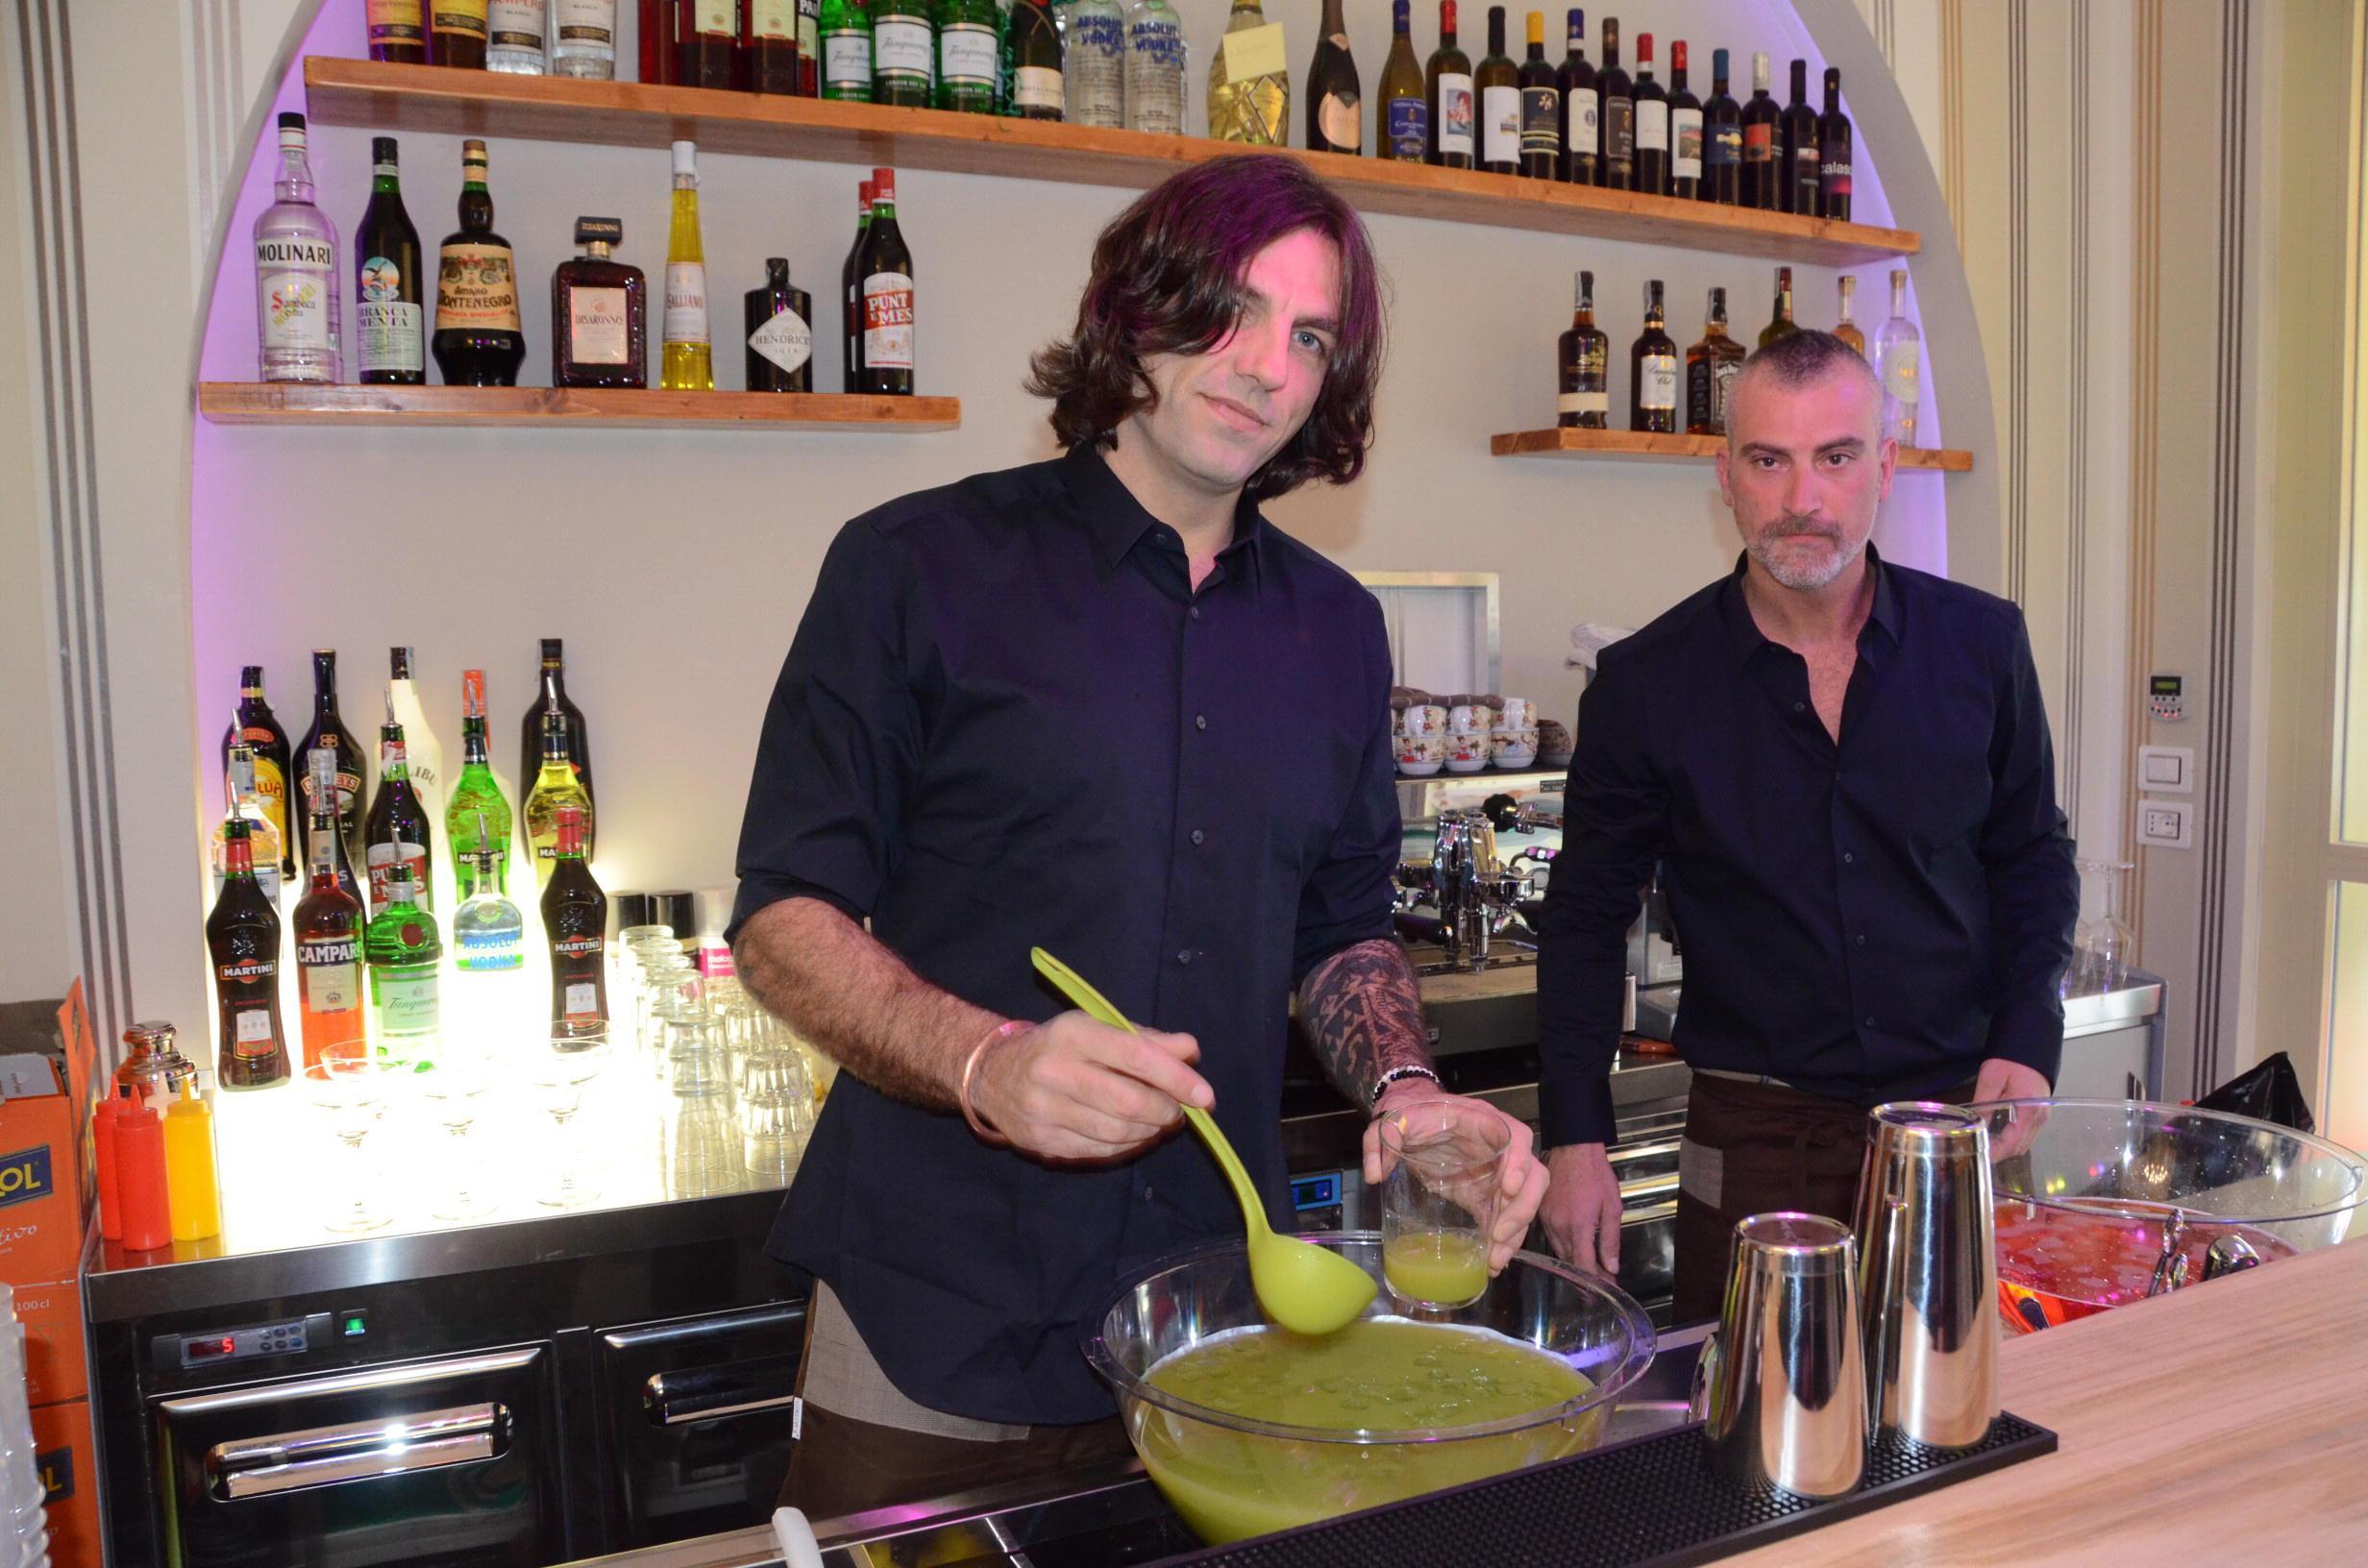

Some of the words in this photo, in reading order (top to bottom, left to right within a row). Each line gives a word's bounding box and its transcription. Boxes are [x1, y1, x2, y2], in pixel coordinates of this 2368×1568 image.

[258, 243, 331, 265] MOLINARI
[868, 292, 908, 311] PUNT
[358, 306, 407, 317] BRANCA
[877, 307, 912, 325] MES
[359, 318, 407, 327] MENTA
[575, 314, 623, 325] DISARONNO
[554, 938, 601, 952] MARTINI
[470, 955, 517, 969] VODKA
[223, 964, 273, 977] MARTINI
